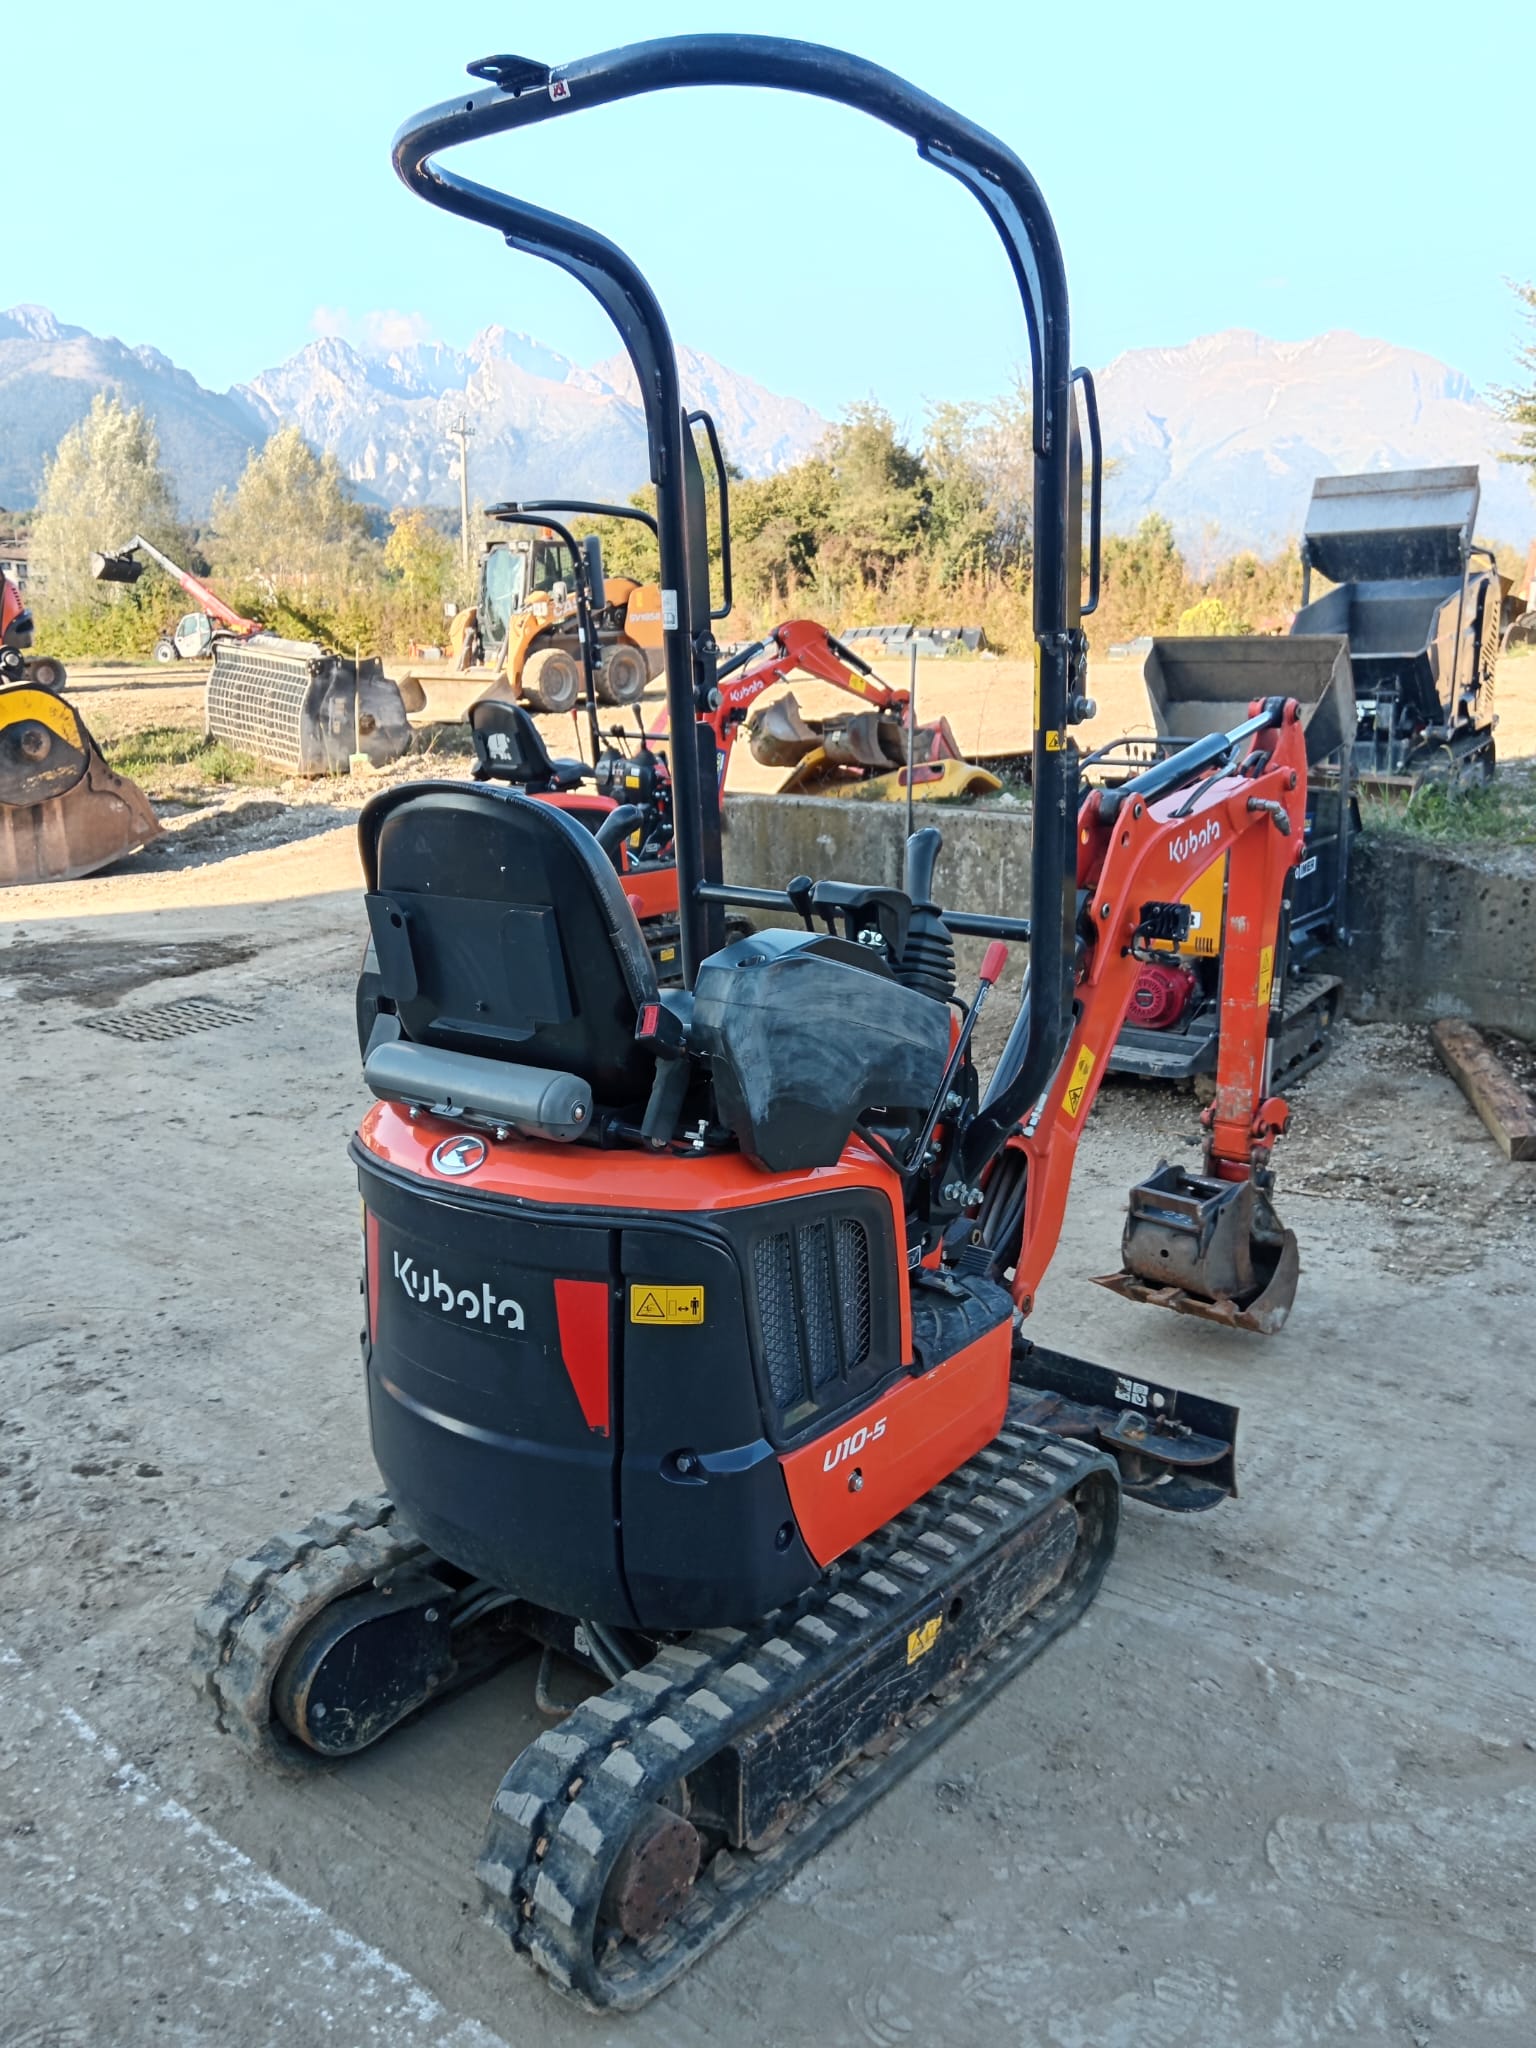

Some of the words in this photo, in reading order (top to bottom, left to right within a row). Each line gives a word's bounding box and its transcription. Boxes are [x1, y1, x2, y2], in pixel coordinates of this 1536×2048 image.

[730, 680, 764, 702] Kubota
[1169, 818, 1221, 864] Kubota
[393, 1250, 525, 1331] Kubota
[823, 1416, 888, 1472] U10-5
